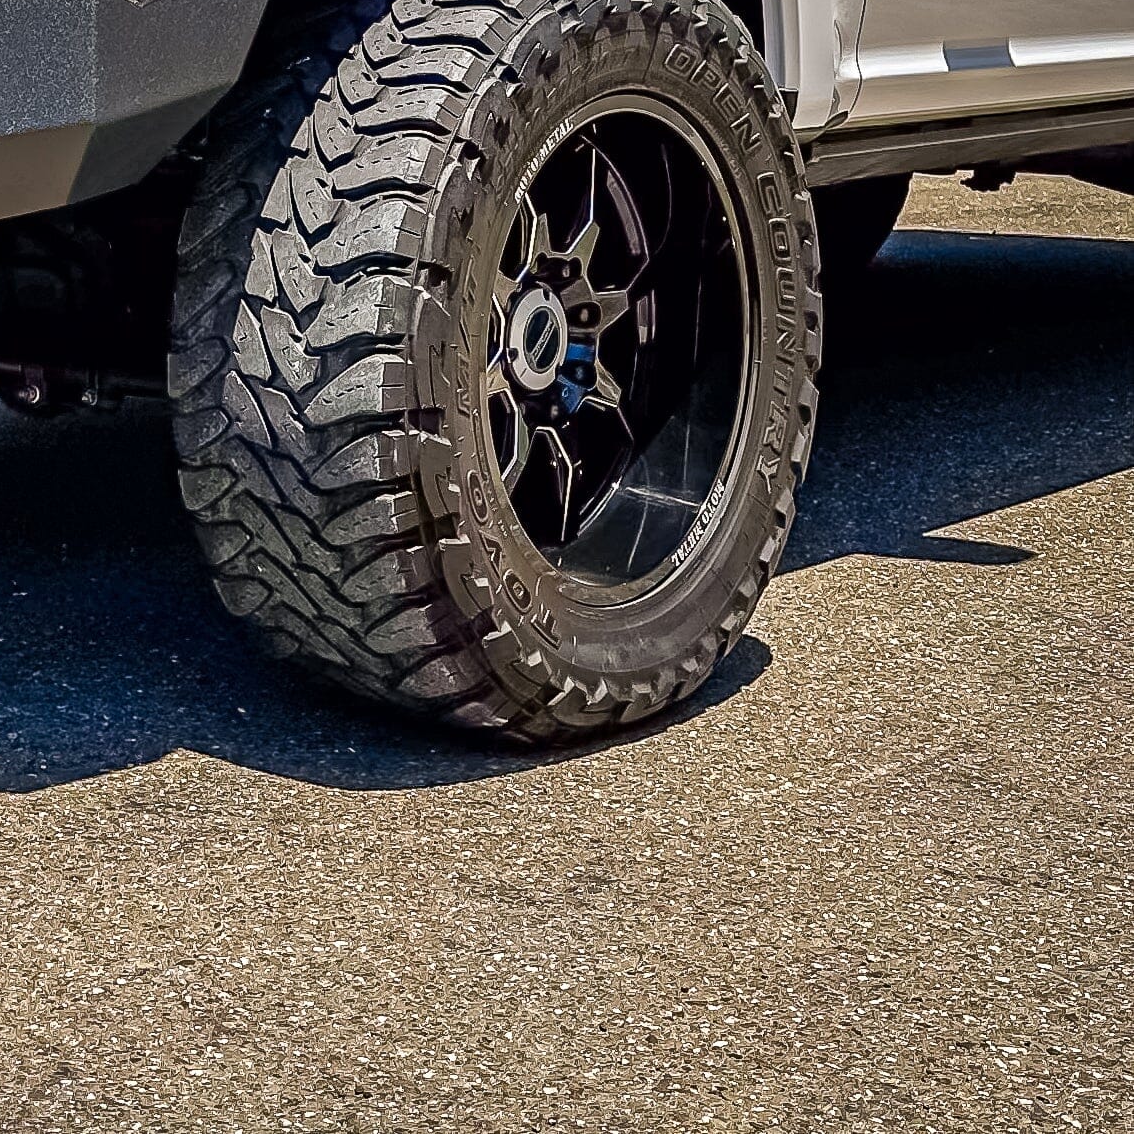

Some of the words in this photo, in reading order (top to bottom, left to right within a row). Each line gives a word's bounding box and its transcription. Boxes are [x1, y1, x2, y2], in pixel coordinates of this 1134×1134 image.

[664, 42, 762, 156] OPEN
[755, 170, 797, 494] COUNTRY
[466, 469, 563, 651] TOYO
